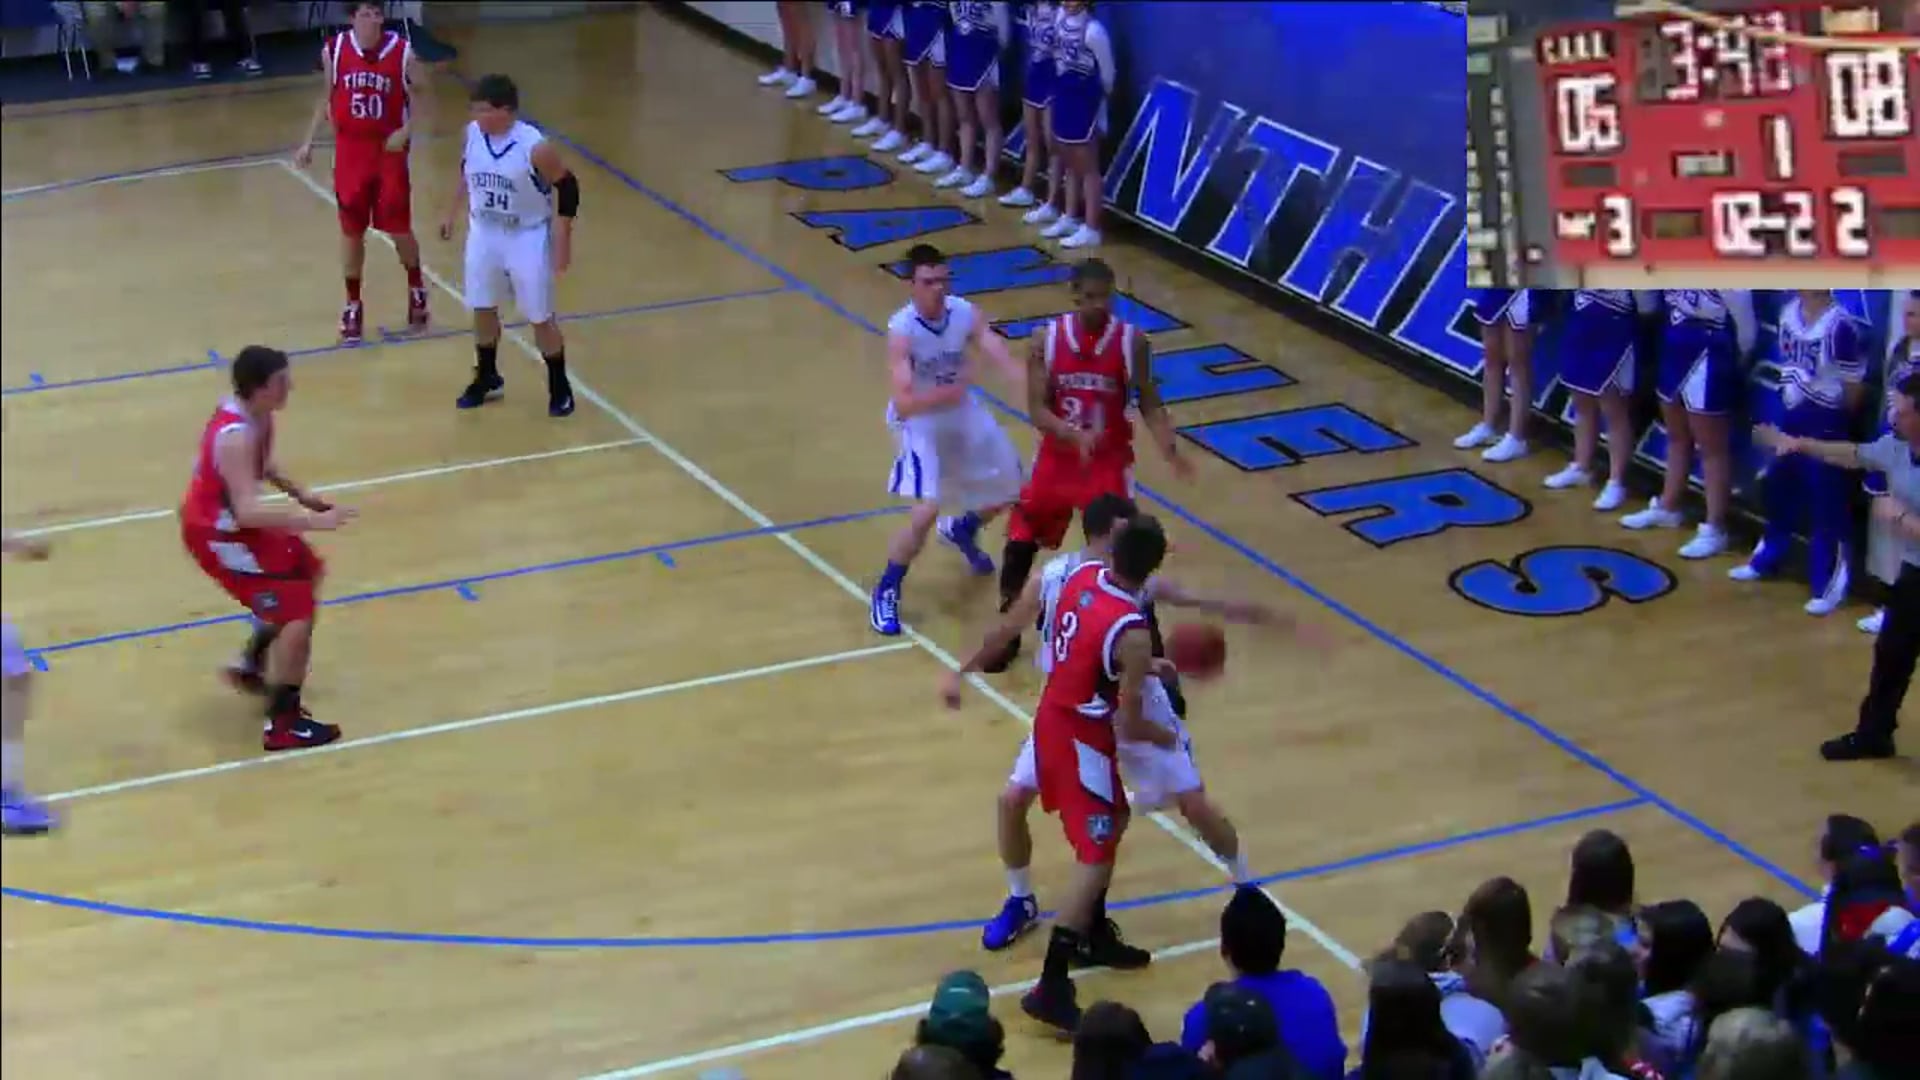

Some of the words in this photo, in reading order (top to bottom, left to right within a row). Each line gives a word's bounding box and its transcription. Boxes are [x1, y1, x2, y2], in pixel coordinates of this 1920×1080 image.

[351, 93, 383, 119] 50
[1826, 48, 1909, 137] 08
[1773, 116, 1793, 179] 1
[484, 191, 508, 211] 34
[1604, 196, 1635, 256] 3
